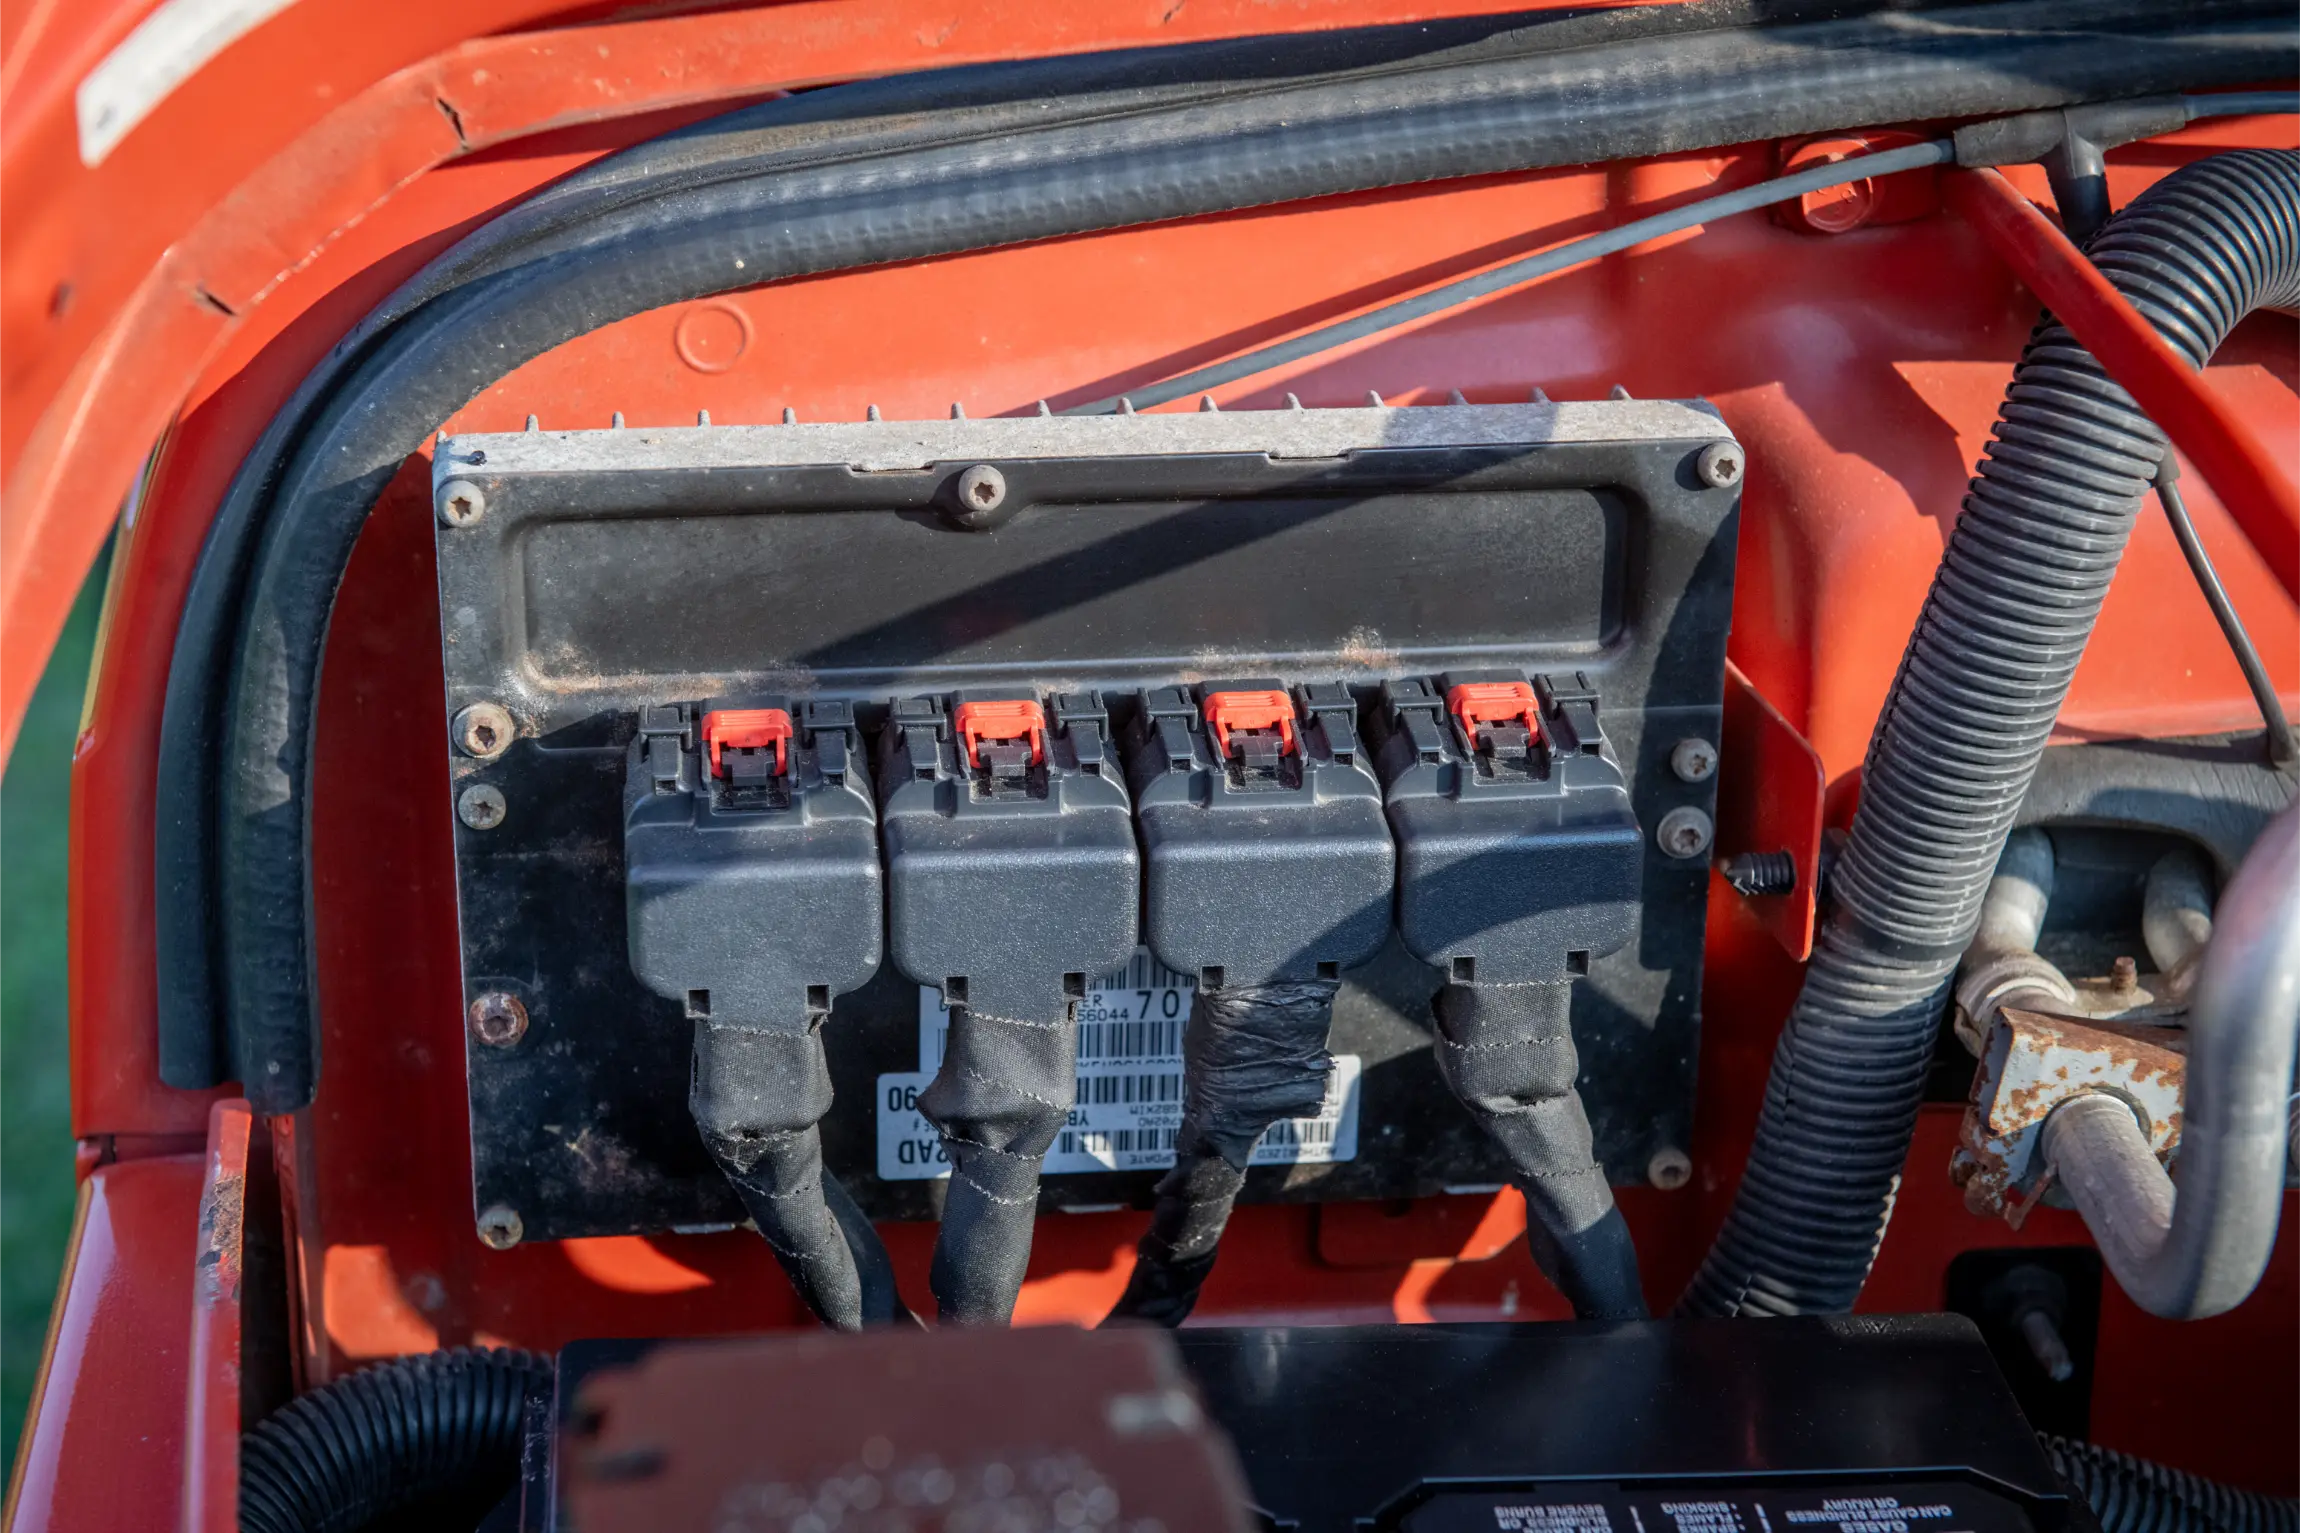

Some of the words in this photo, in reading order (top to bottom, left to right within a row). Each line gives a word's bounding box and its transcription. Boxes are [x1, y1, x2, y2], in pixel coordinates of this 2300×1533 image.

[1545, 1504, 1604, 1518] SEVERE
[1661, 1501, 1729, 1514] SMOKING
[1822, 1497, 1873, 1511] INJURY
[1919, 1504, 1953, 1517] CAN
[1494, 1505, 1544, 1519] BURNS
[1674, 1513, 1733, 1523] FLAMES
[1785, 1508, 1867, 1522] BLINDNESS
[1867, 1506, 1919, 1520] CAUSE
[1526, 1515, 1610, 1528] BLINDNESS
